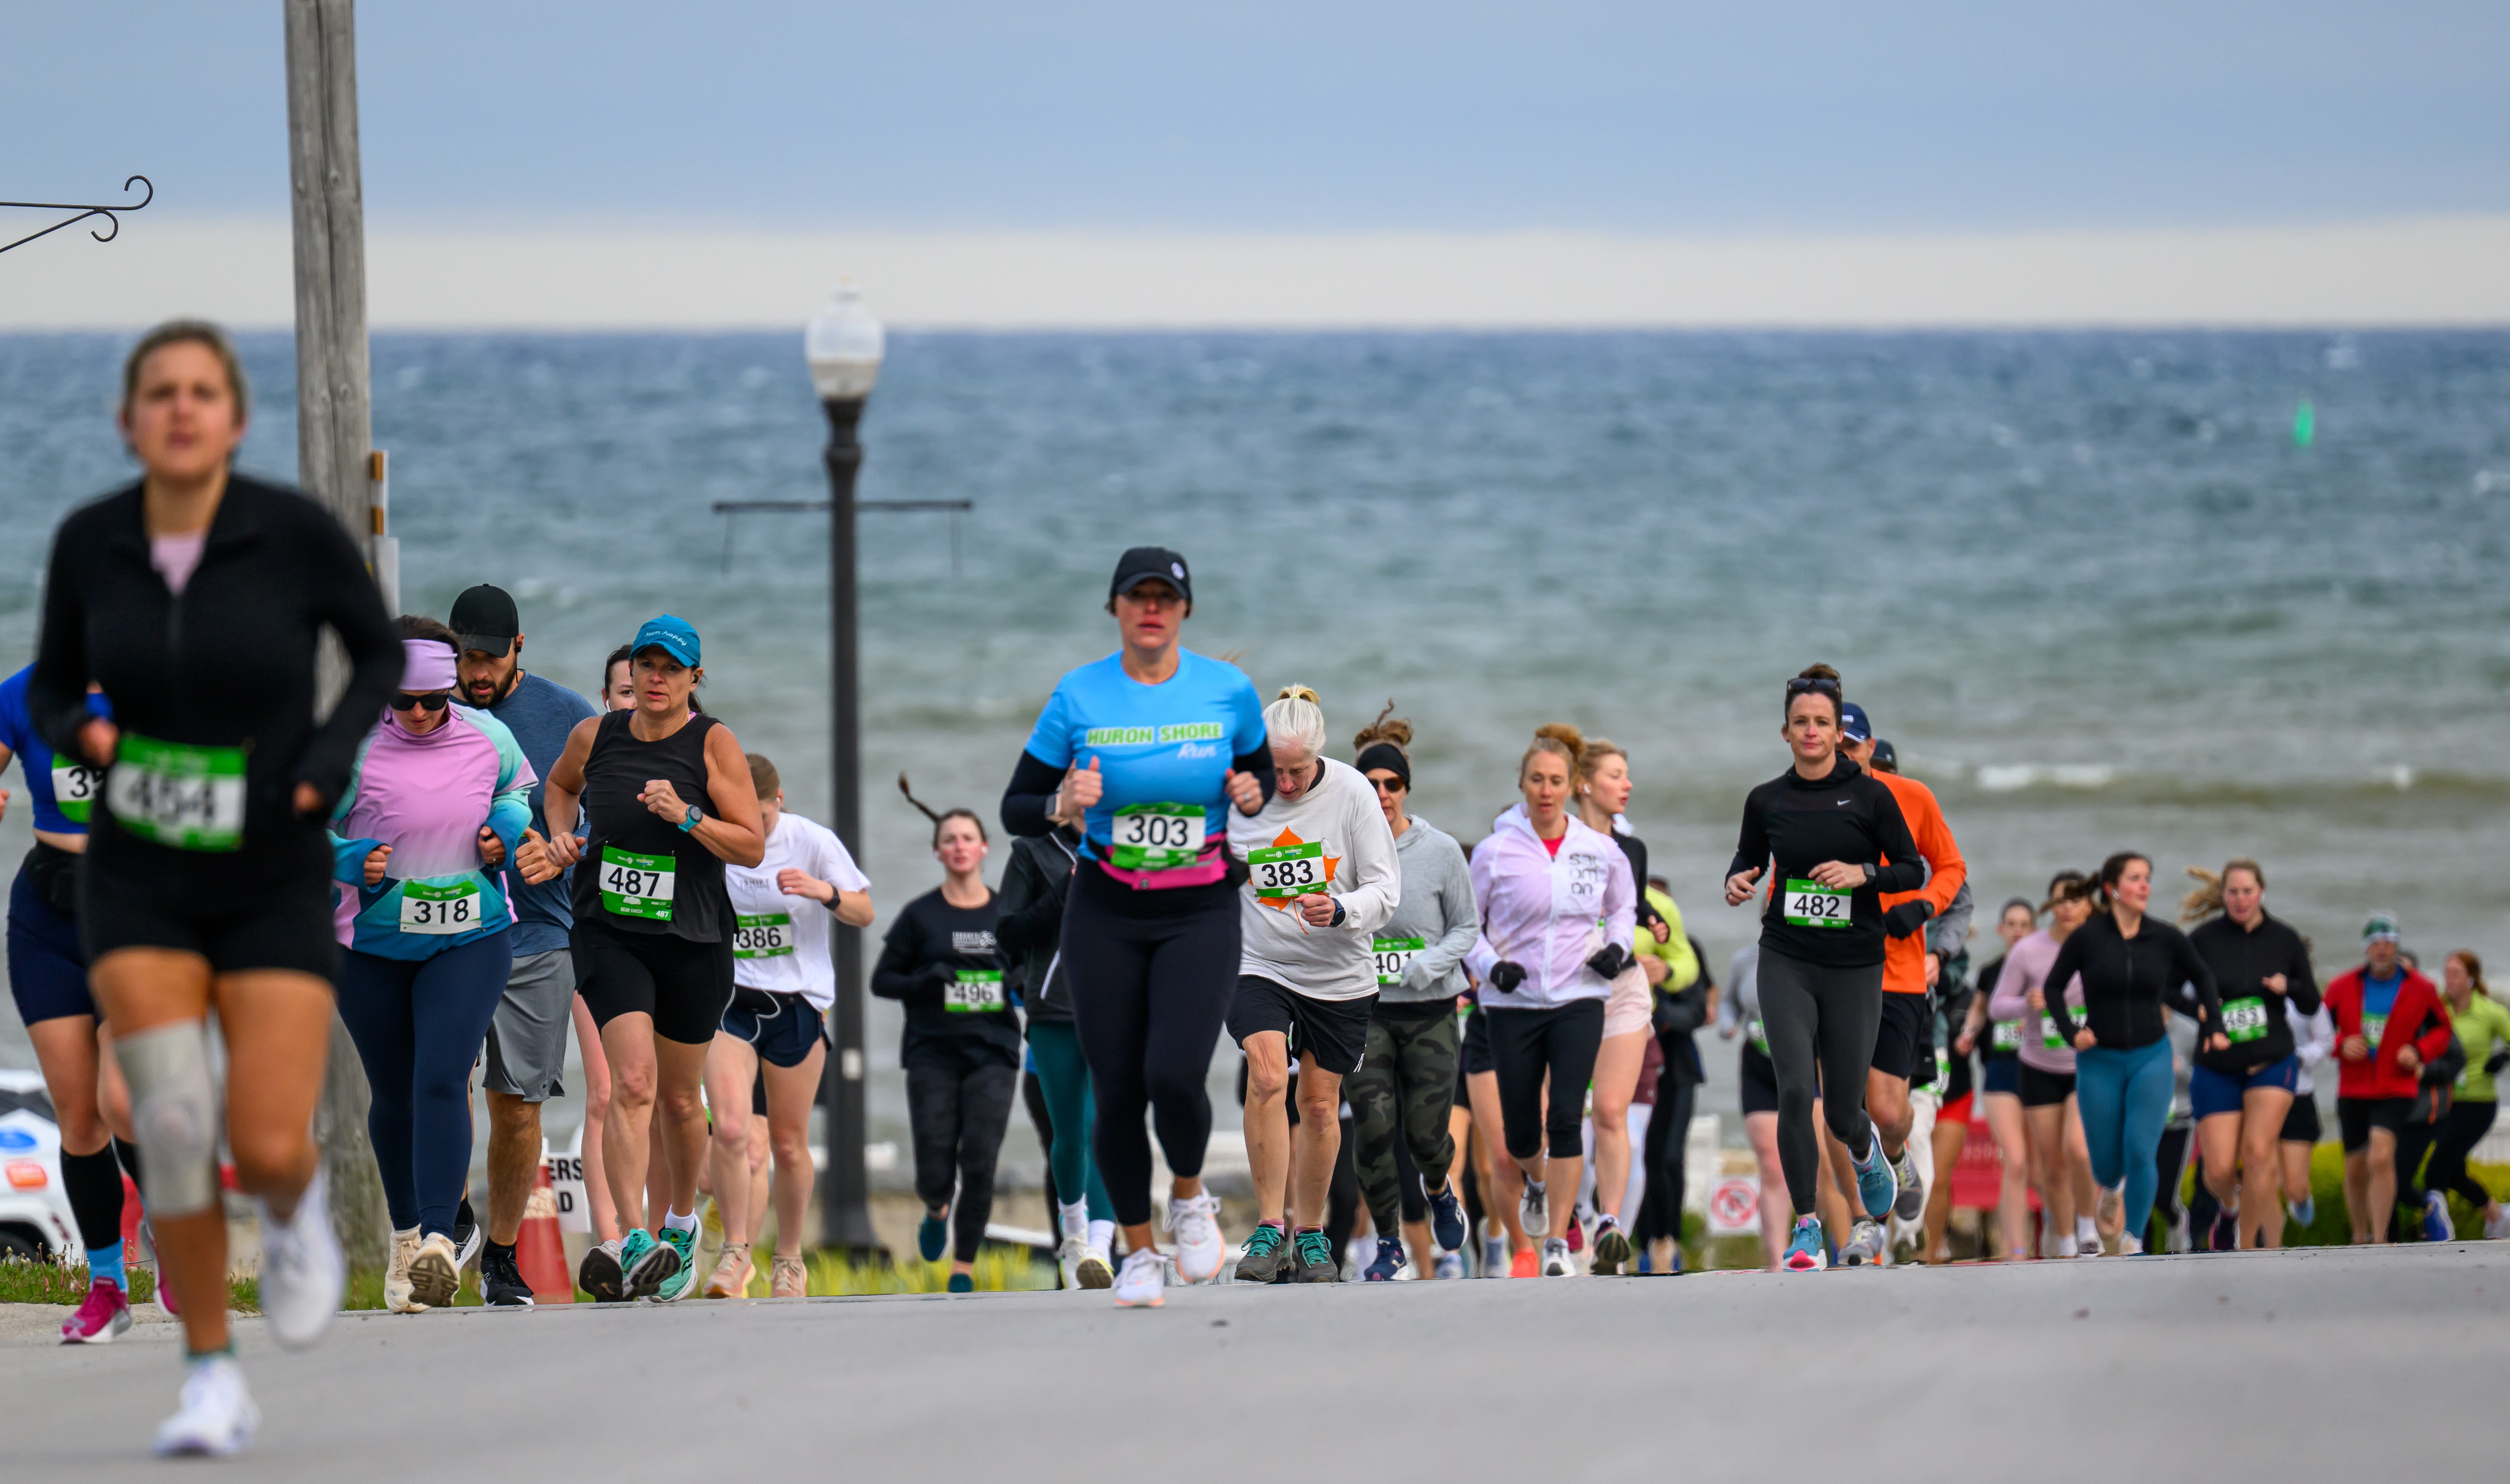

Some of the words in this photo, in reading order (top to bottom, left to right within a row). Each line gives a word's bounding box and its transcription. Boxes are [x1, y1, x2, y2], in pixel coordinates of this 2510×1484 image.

[661, 630, 687, 646] happy
[1087, 727, 1154, 747] HURON
[1159, 723, 1223, 742] SHORE
[1177, 742, 1217, 760] Run
[1127, 815, 1188, 846] 303
[608, 867, 660, 897] 487
[1261, 860, 1313, 887] 383
[414, 899, 469, 924] 318
[656, 910, 669, 918] 487
[1794, 895, 1840, 917] 482
[739, 927, 781, 949] 386
[954, 985, 993, 1002] 496
